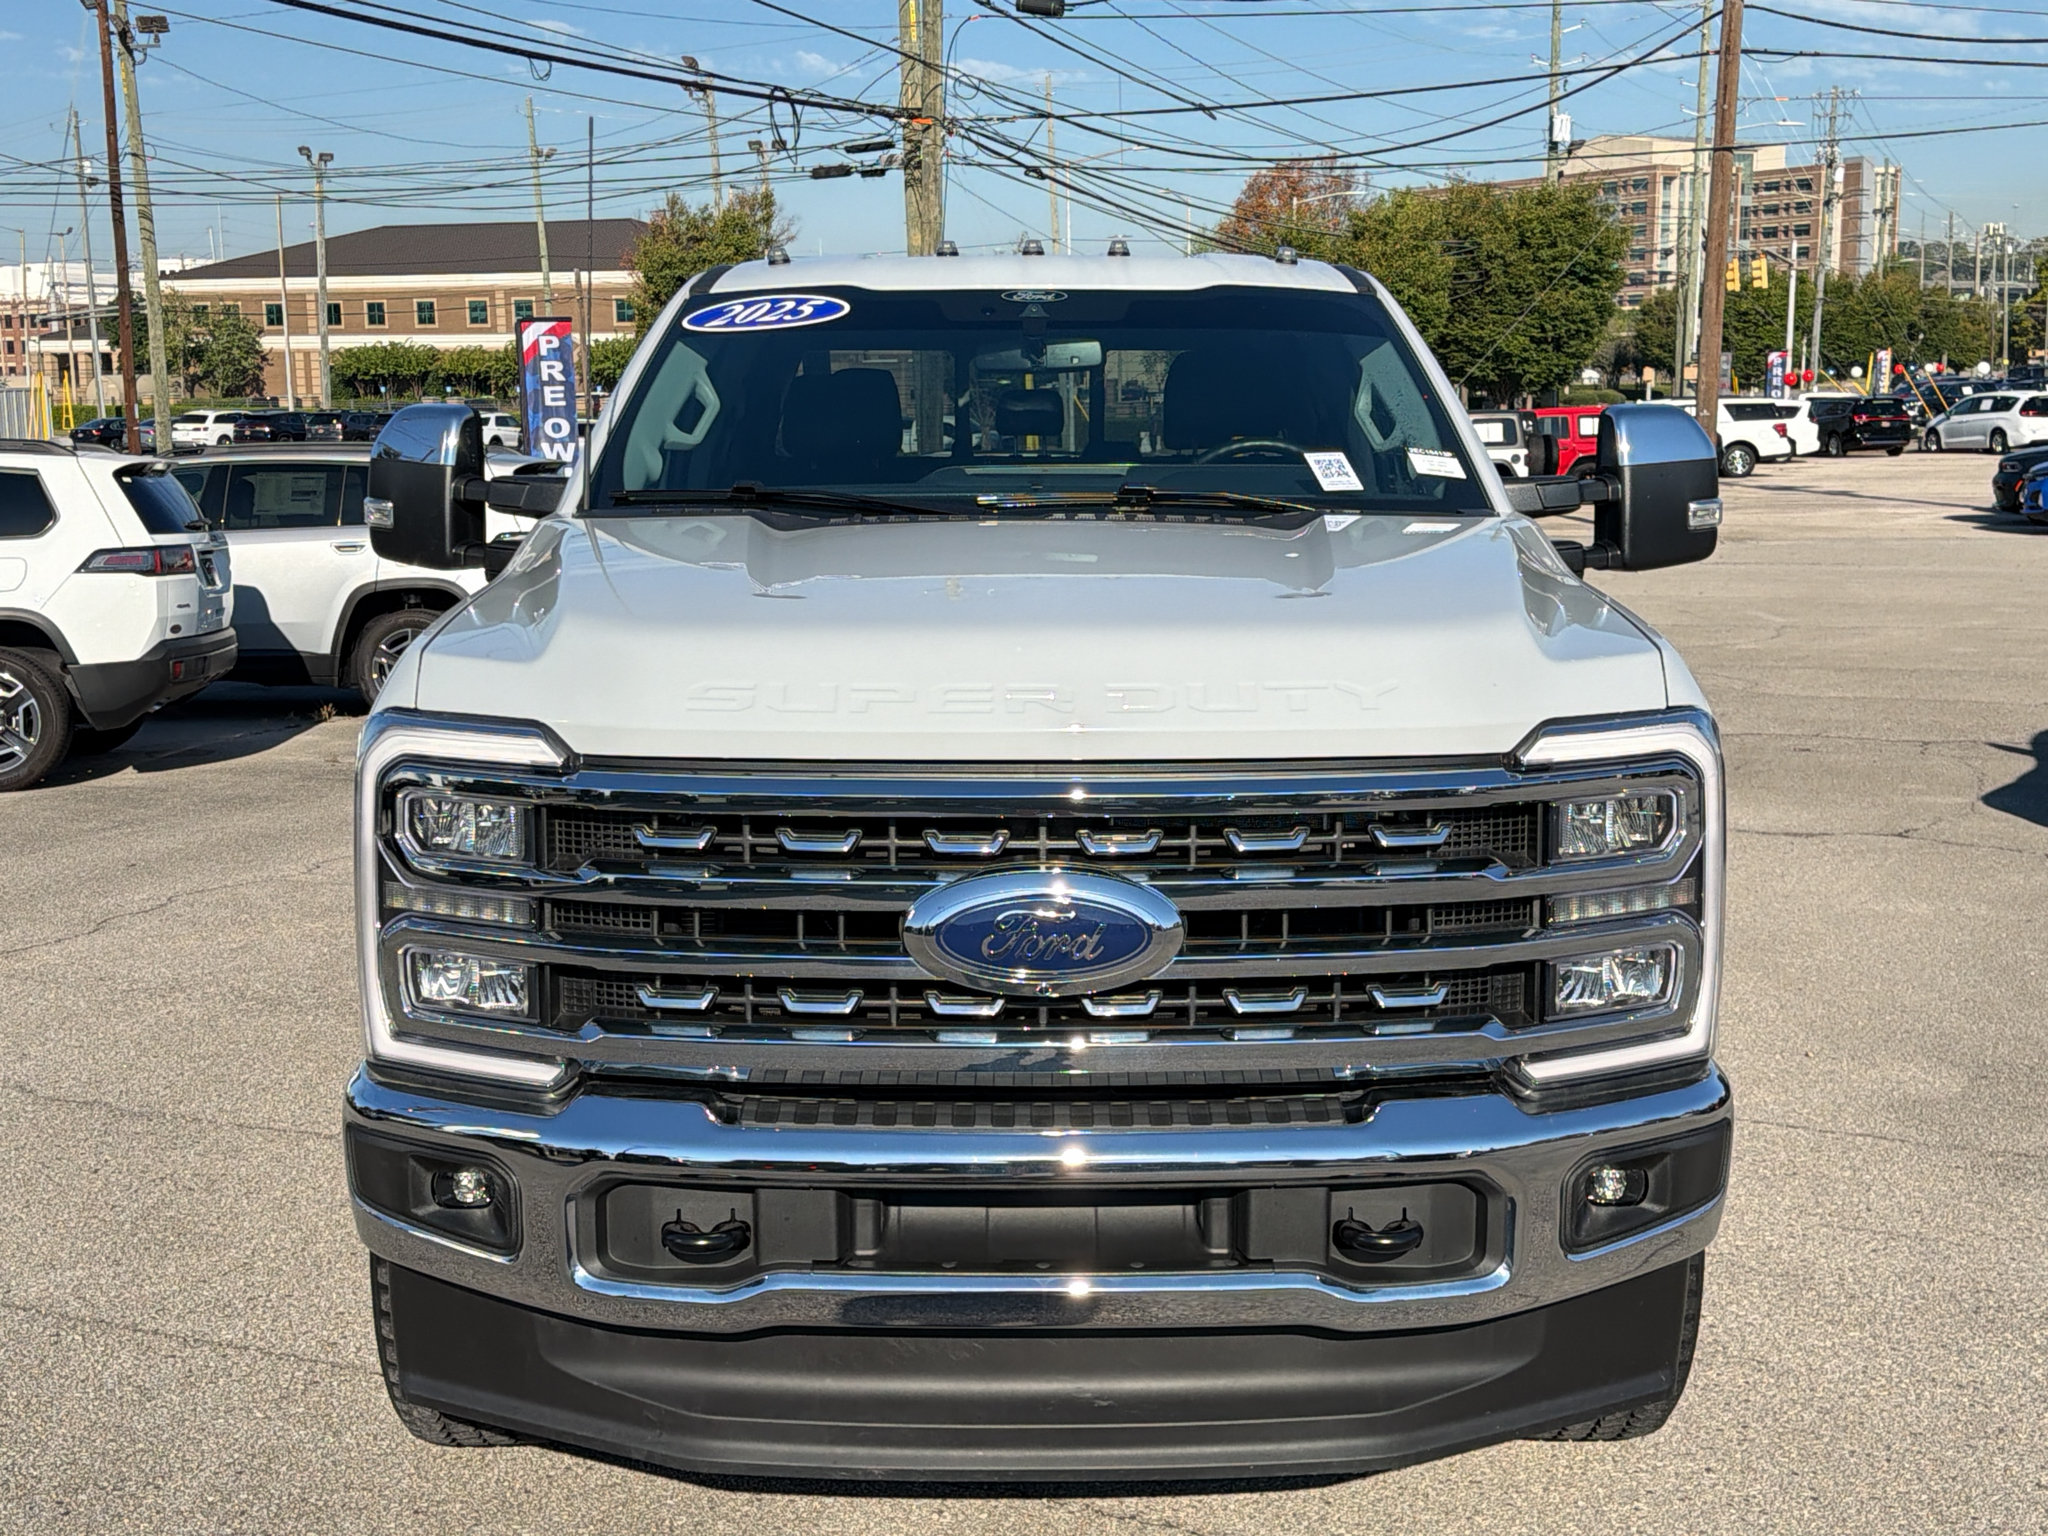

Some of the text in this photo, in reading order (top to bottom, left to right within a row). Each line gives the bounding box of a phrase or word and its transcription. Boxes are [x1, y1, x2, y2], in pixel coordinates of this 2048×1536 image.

[1013, 290, 1056, 301] Ford
[703, 300, 826, 327] 2025
[685, 679, 1399, 715] SUPER DUTY
[981, 909, 1105, 961] Ford
